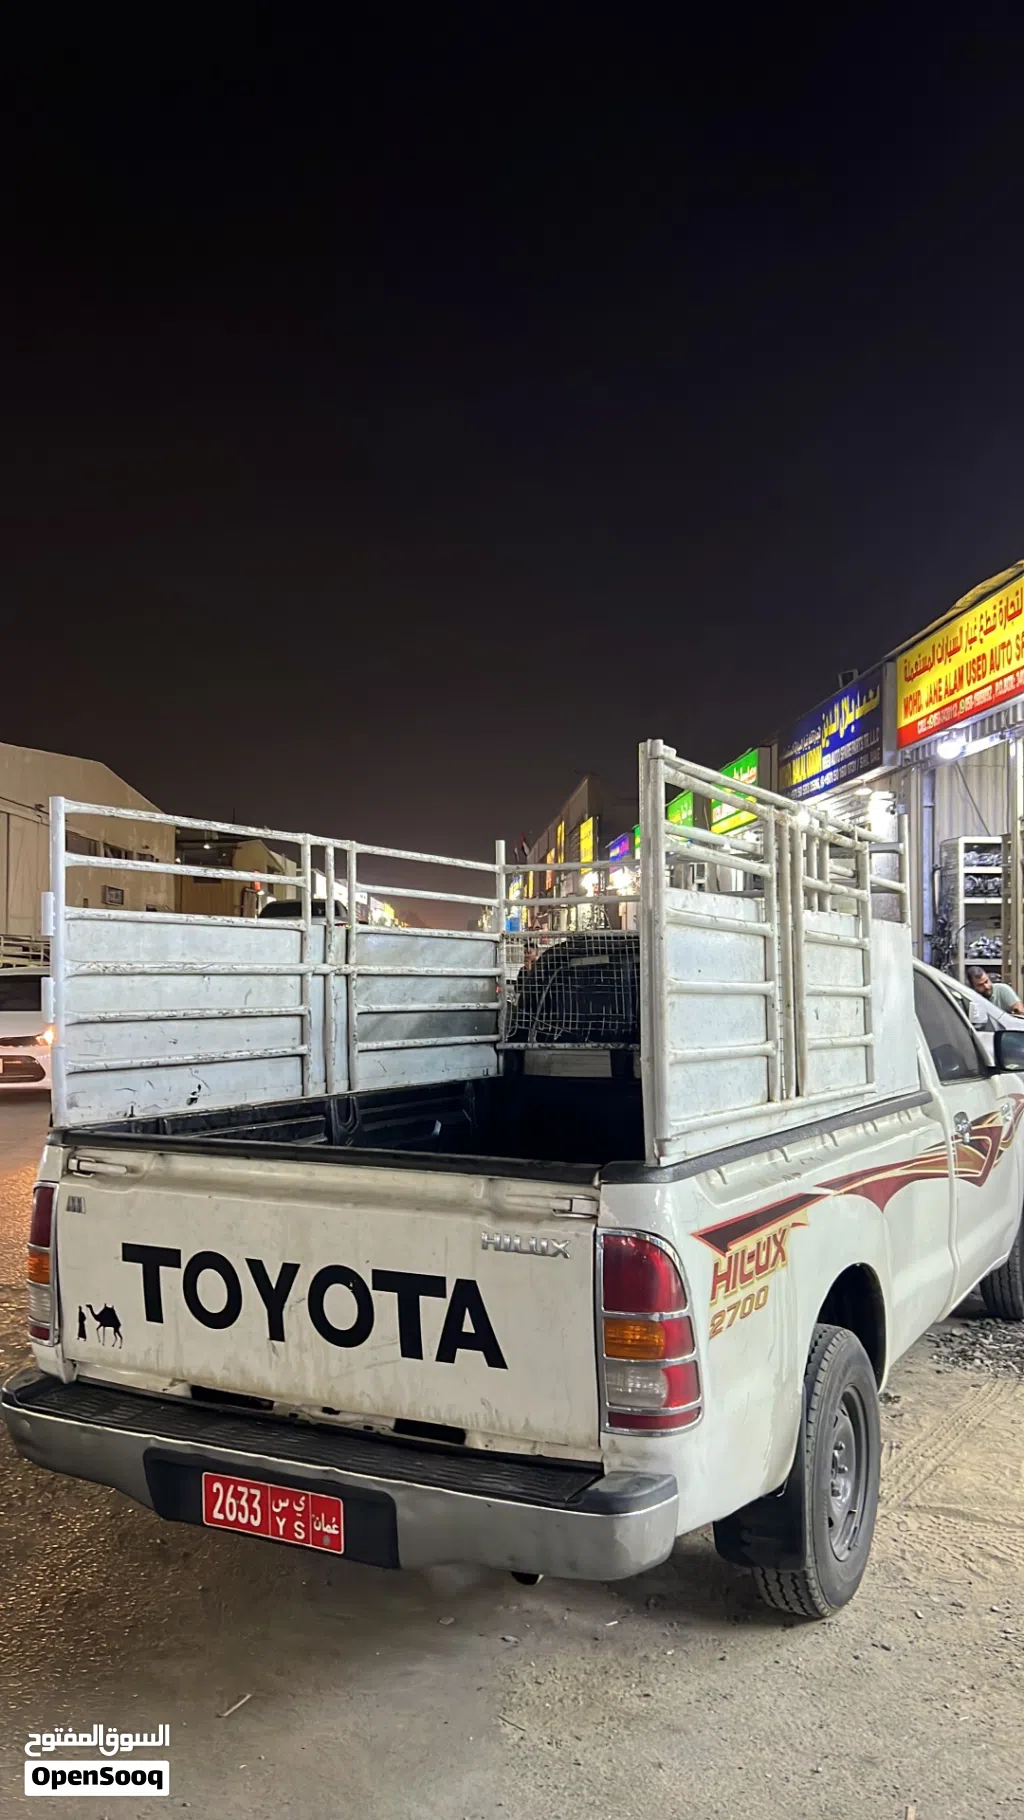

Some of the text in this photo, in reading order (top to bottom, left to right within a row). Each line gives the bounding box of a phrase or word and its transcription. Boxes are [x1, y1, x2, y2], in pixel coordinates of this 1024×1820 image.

[964, 618, 977, 653] غيار
[979, 604, 997, 644] قطع
[903, 643, 936, 683] المستعملة
[936, 626, 963, 665] السيارات
[944, 666, 964, 696] ALAM
[966, 653, 987, 686] USED
[989, 639, 1013, 675] AUTO
[481, 1231, 571, 1259] HILUX
[710, 1226, 788, 1304] HILUX
[121, 1242, 509, 1370] TOYOTA
[709, 1285, 769, 1340] 2700
[212, 1482, 262, 1527] 2633
